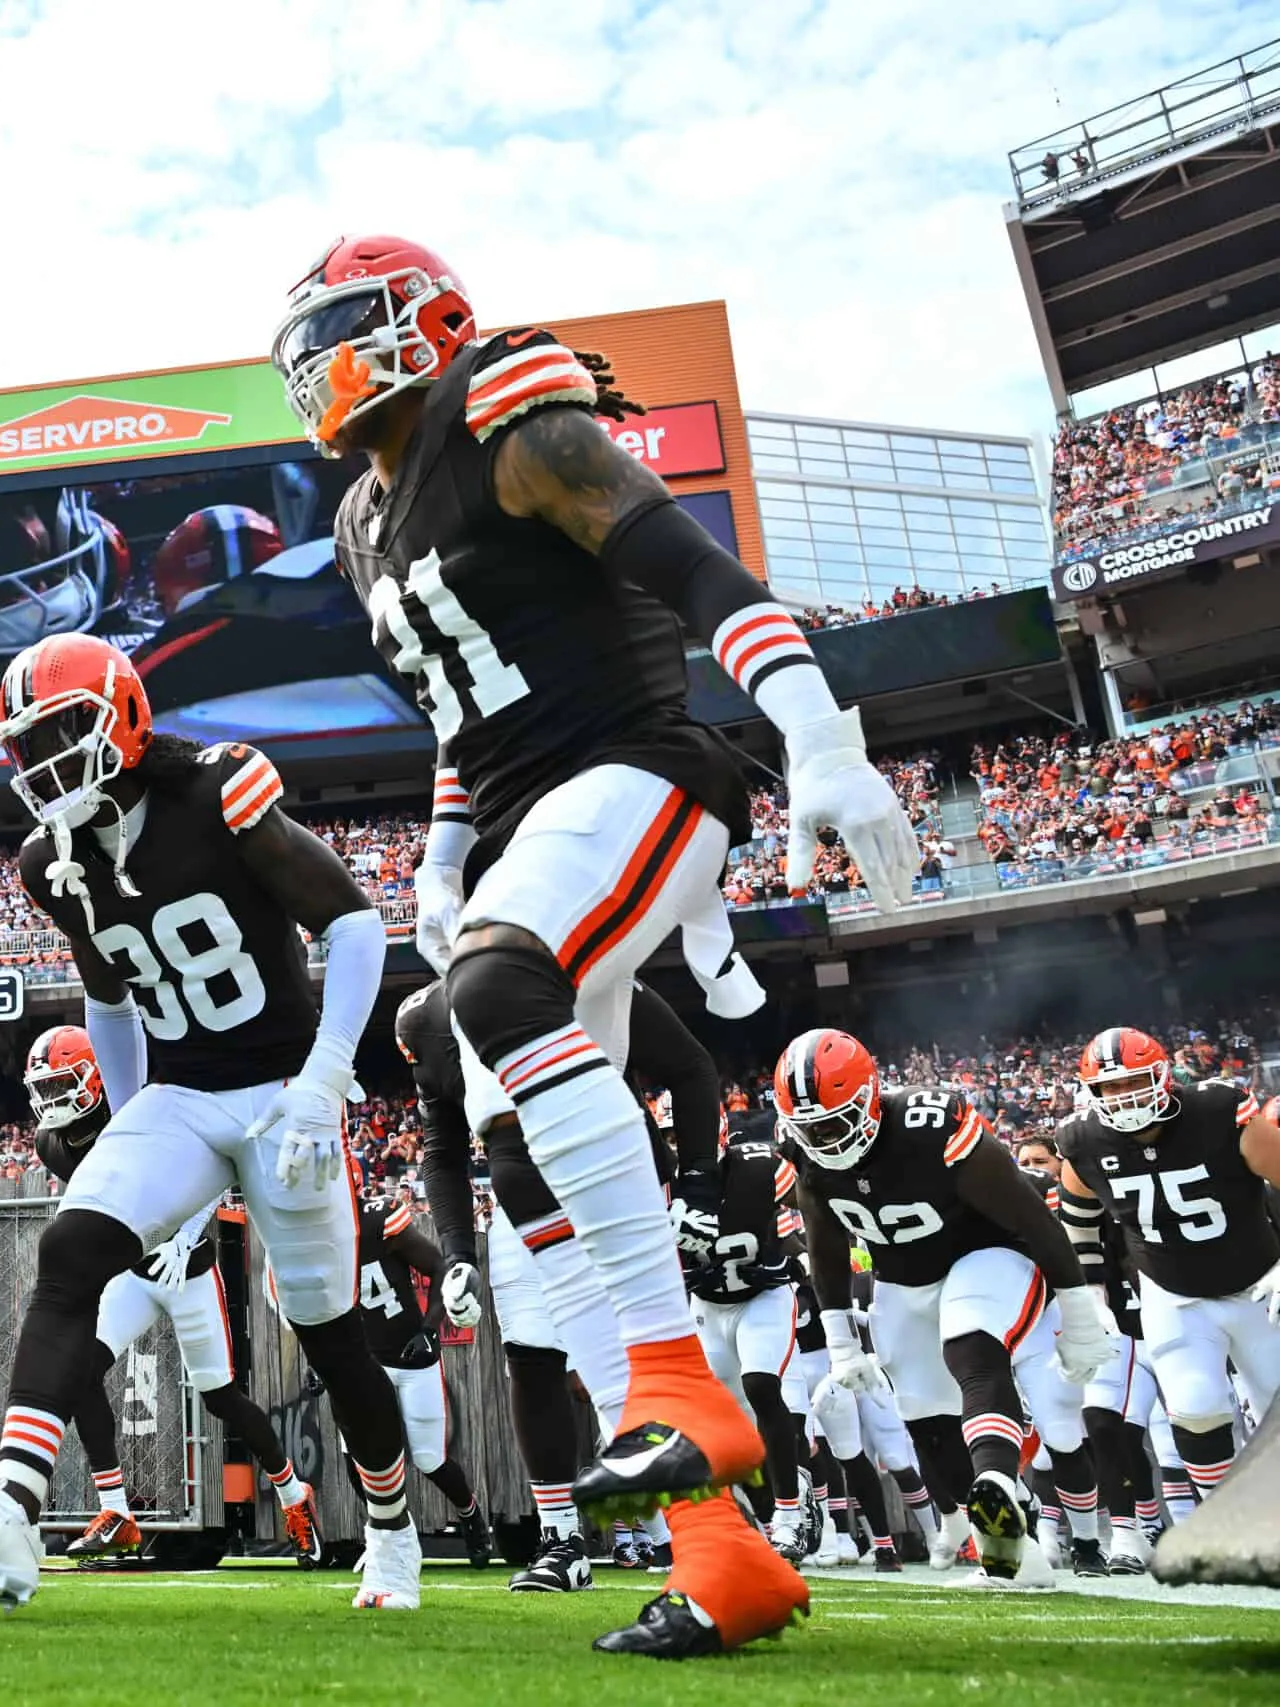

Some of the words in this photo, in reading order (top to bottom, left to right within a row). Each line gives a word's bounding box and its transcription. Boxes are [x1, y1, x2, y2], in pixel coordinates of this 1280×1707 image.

[0, 413, 166, 453] SERVPRO
[1099, 507, 1272, 570] CROSSCOUNTRY
[1103, 547, 1196, 583] MORTGAGE
[91, 892, 266, 1040] 38
[905, 1091, 950, 1128] 92
[1101, 1155, 1120, 1171] C
[1108, 1164, 1228, 1243] 75
